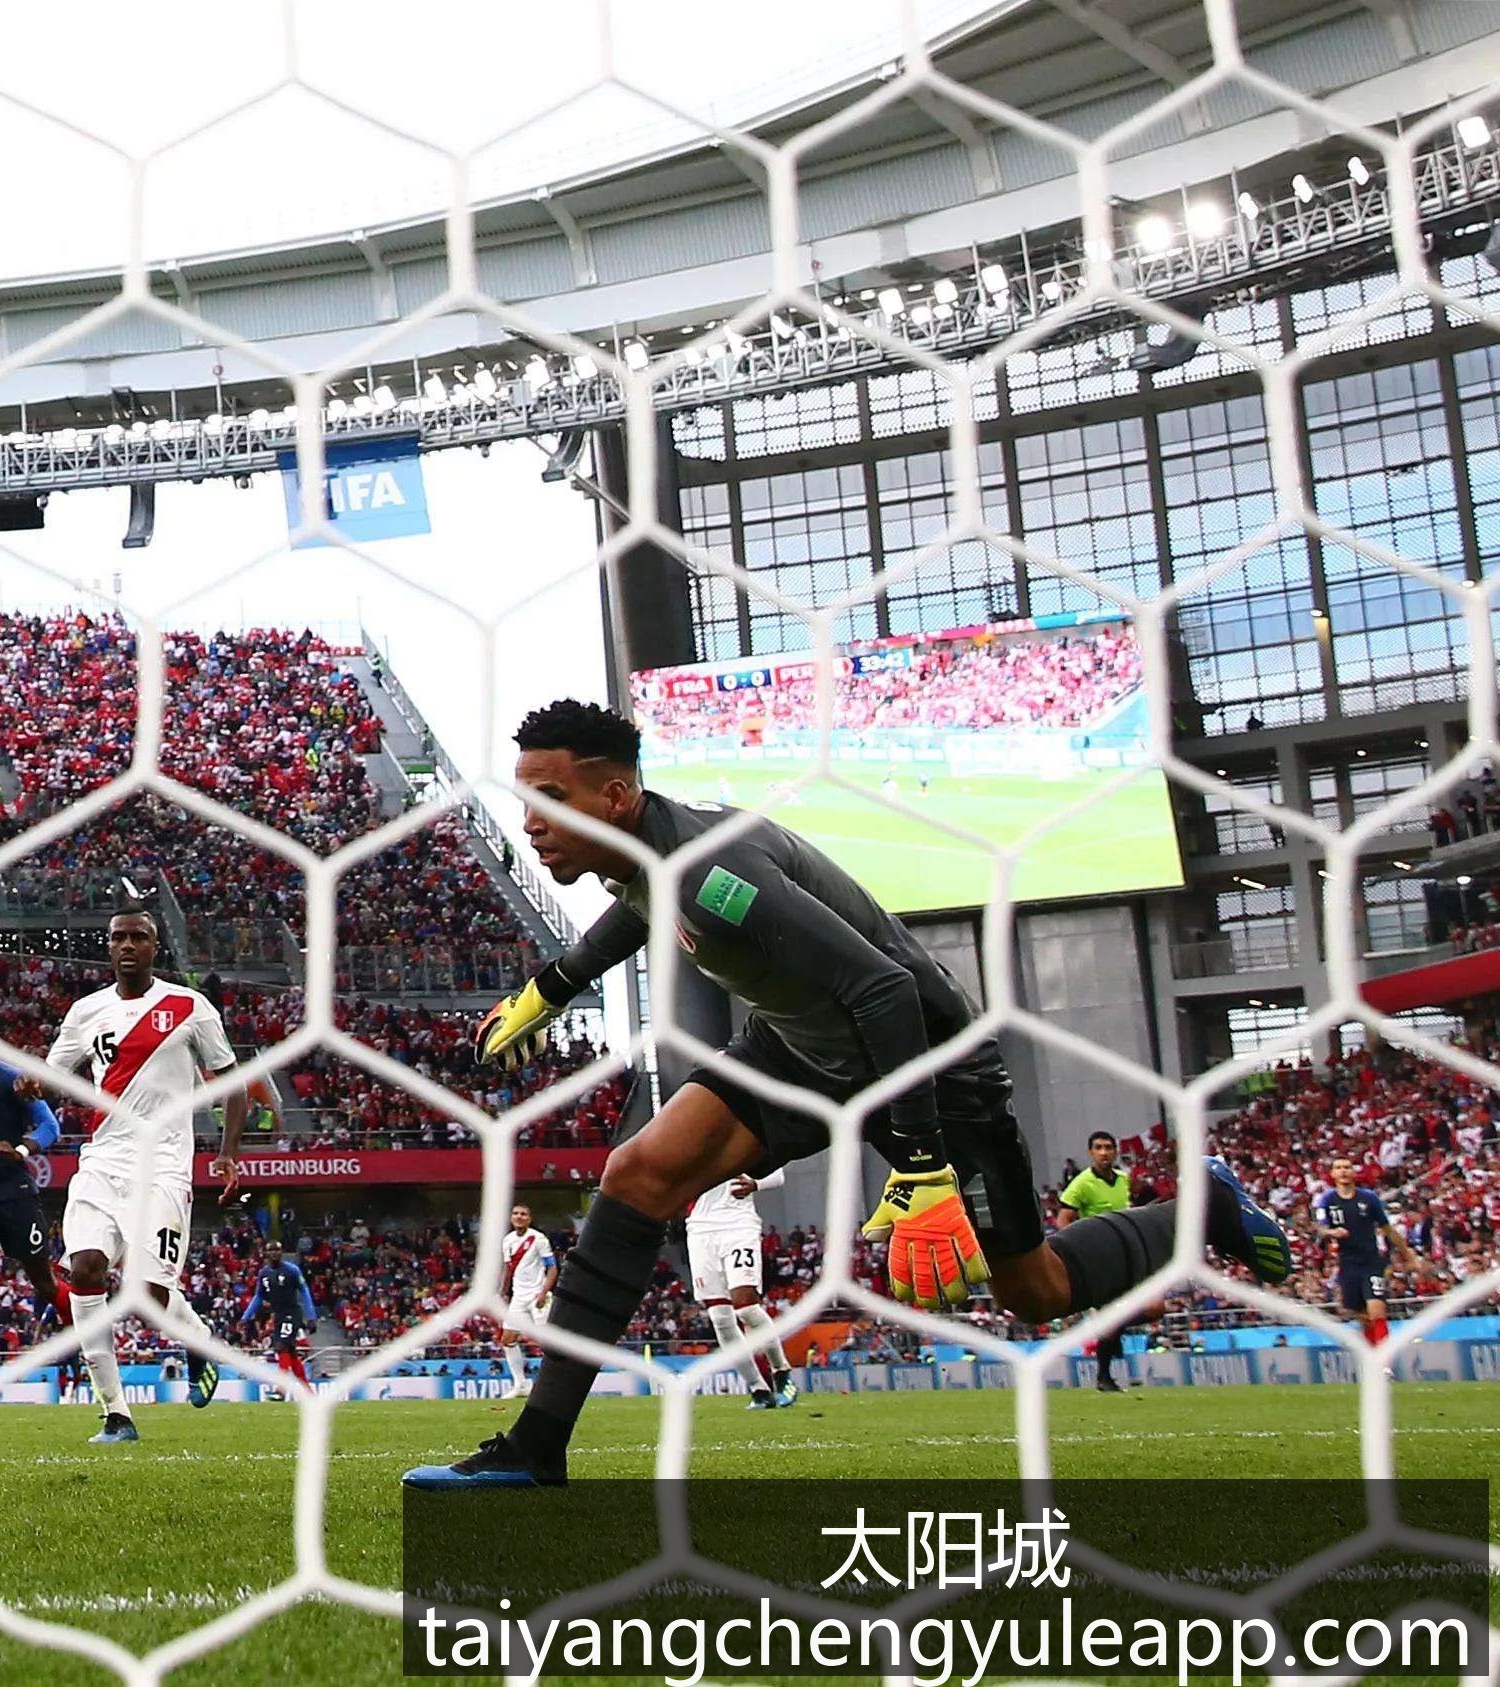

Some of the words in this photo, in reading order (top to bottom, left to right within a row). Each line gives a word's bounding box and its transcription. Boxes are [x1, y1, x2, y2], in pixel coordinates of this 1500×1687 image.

[320, 471, 407, 513] IFA
[93, 1031, 118, 1066] 15
[208, 1158, 361, 1178] EATERINBURG
[29, 1222, 43, 1245] 6
[157, 1227, 182, 1264] 15
[731, 1247, 755, 1269] 23
